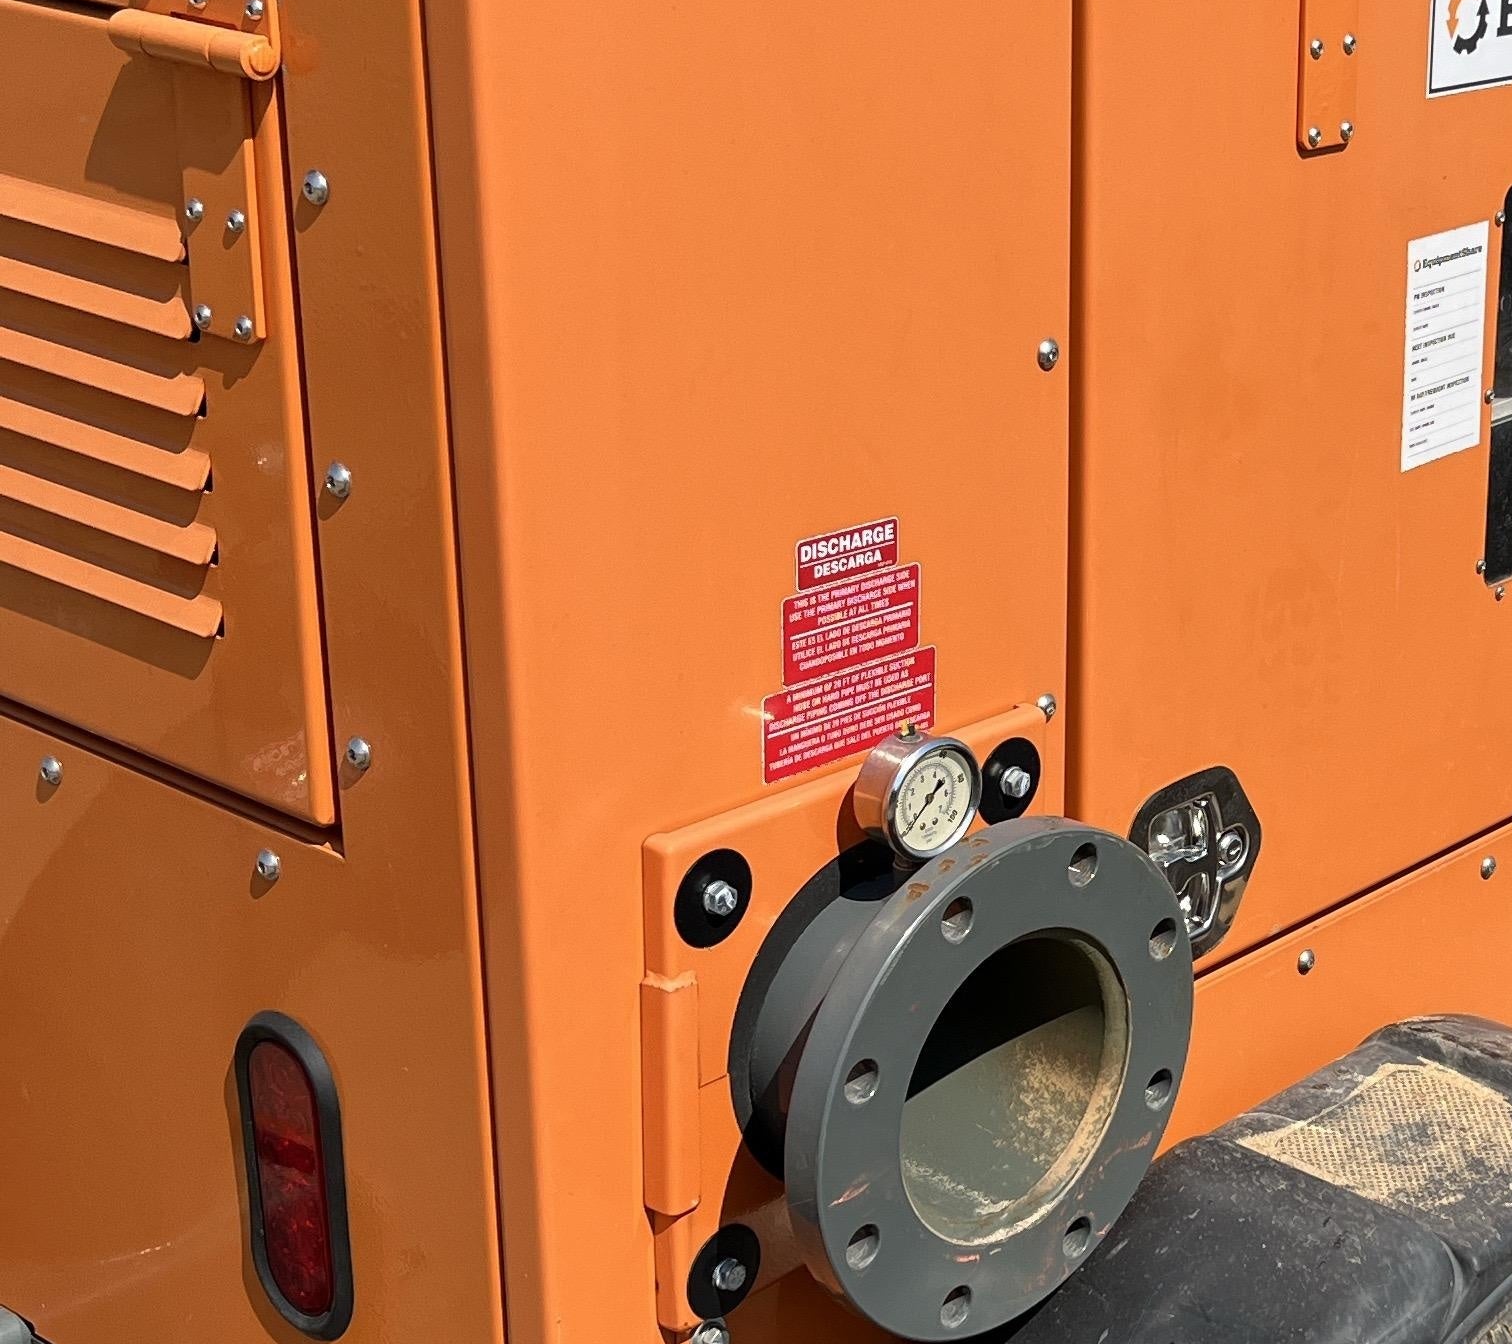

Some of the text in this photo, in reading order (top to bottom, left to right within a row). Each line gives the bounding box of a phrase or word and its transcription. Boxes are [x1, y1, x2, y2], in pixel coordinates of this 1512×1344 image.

[800, 523, 894, 563] DISCHARGE
[814, 550, 882, 578] DESCARGA
[947, 809, 958, 823] 100
